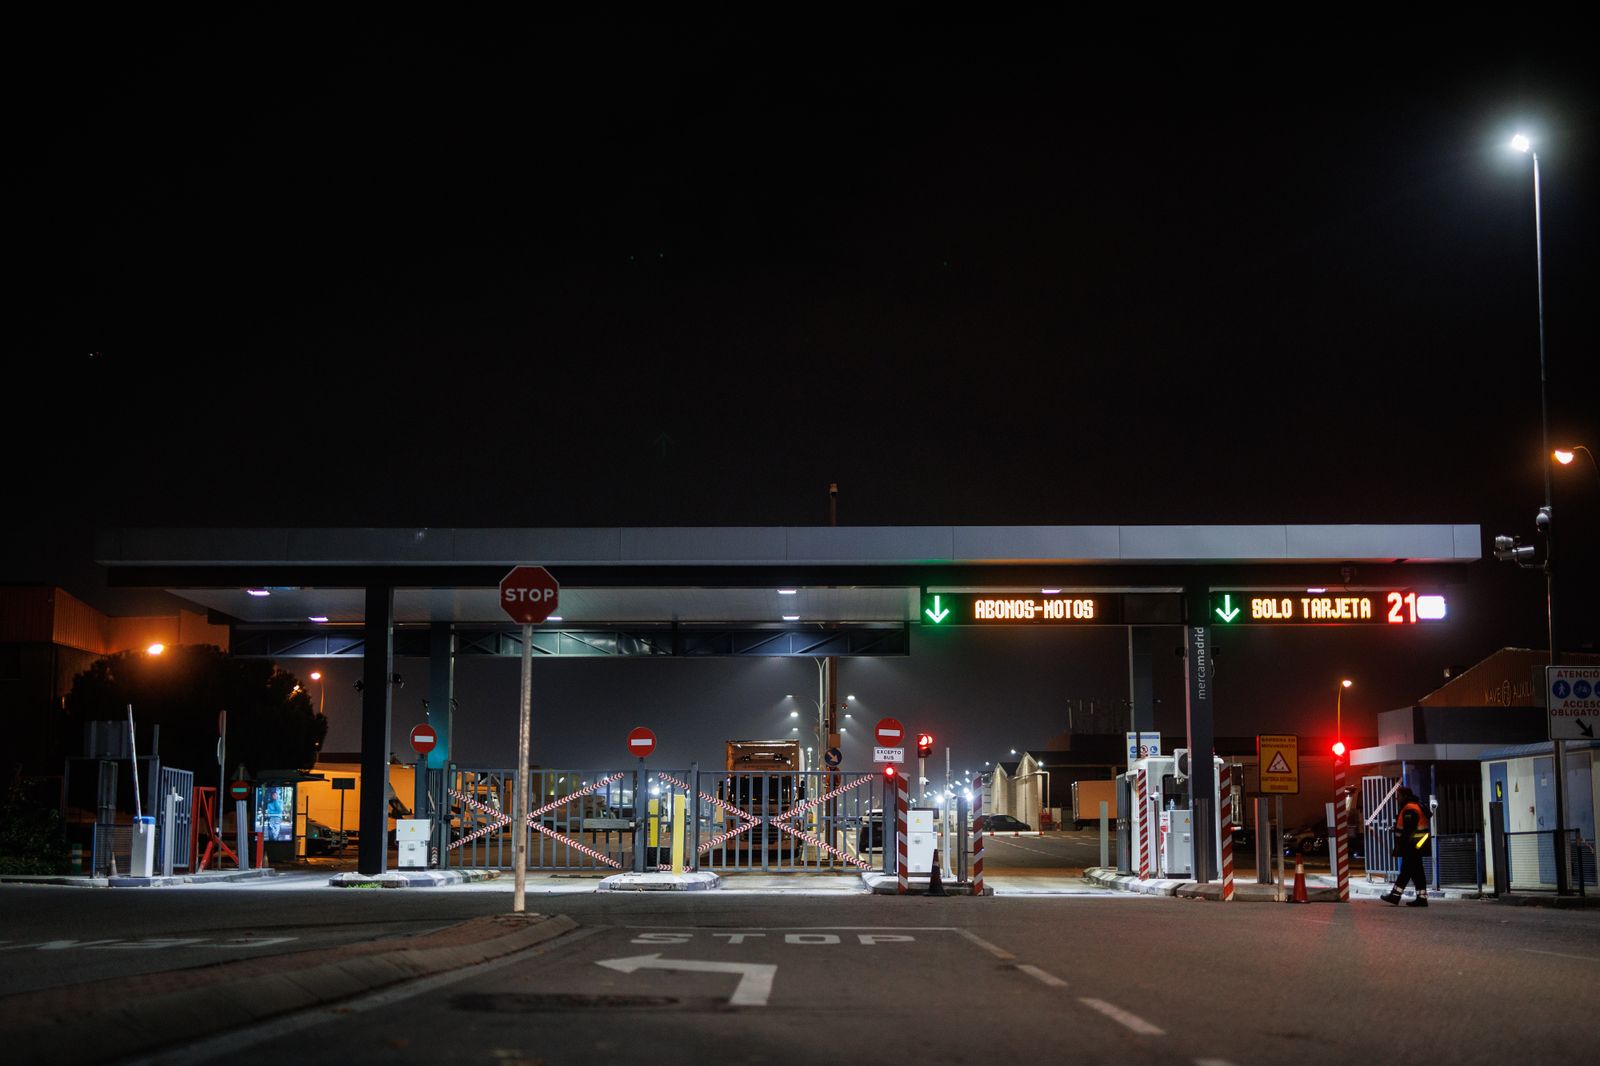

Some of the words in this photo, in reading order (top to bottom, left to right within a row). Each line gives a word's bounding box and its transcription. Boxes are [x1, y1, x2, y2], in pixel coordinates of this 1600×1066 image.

[505, 588, 555, 602] STOP
[975, 599, 1094, 619] ABONOS-MOTOS
[1251, 598, 1293, 619] SOLO
[1301, 598, 1372, 619] TARJETA
[1387, 592, 1417, 623] 21
[1194, 626, 1206, 700] mercamadrid
[630, 932, 916, 945] STOP
